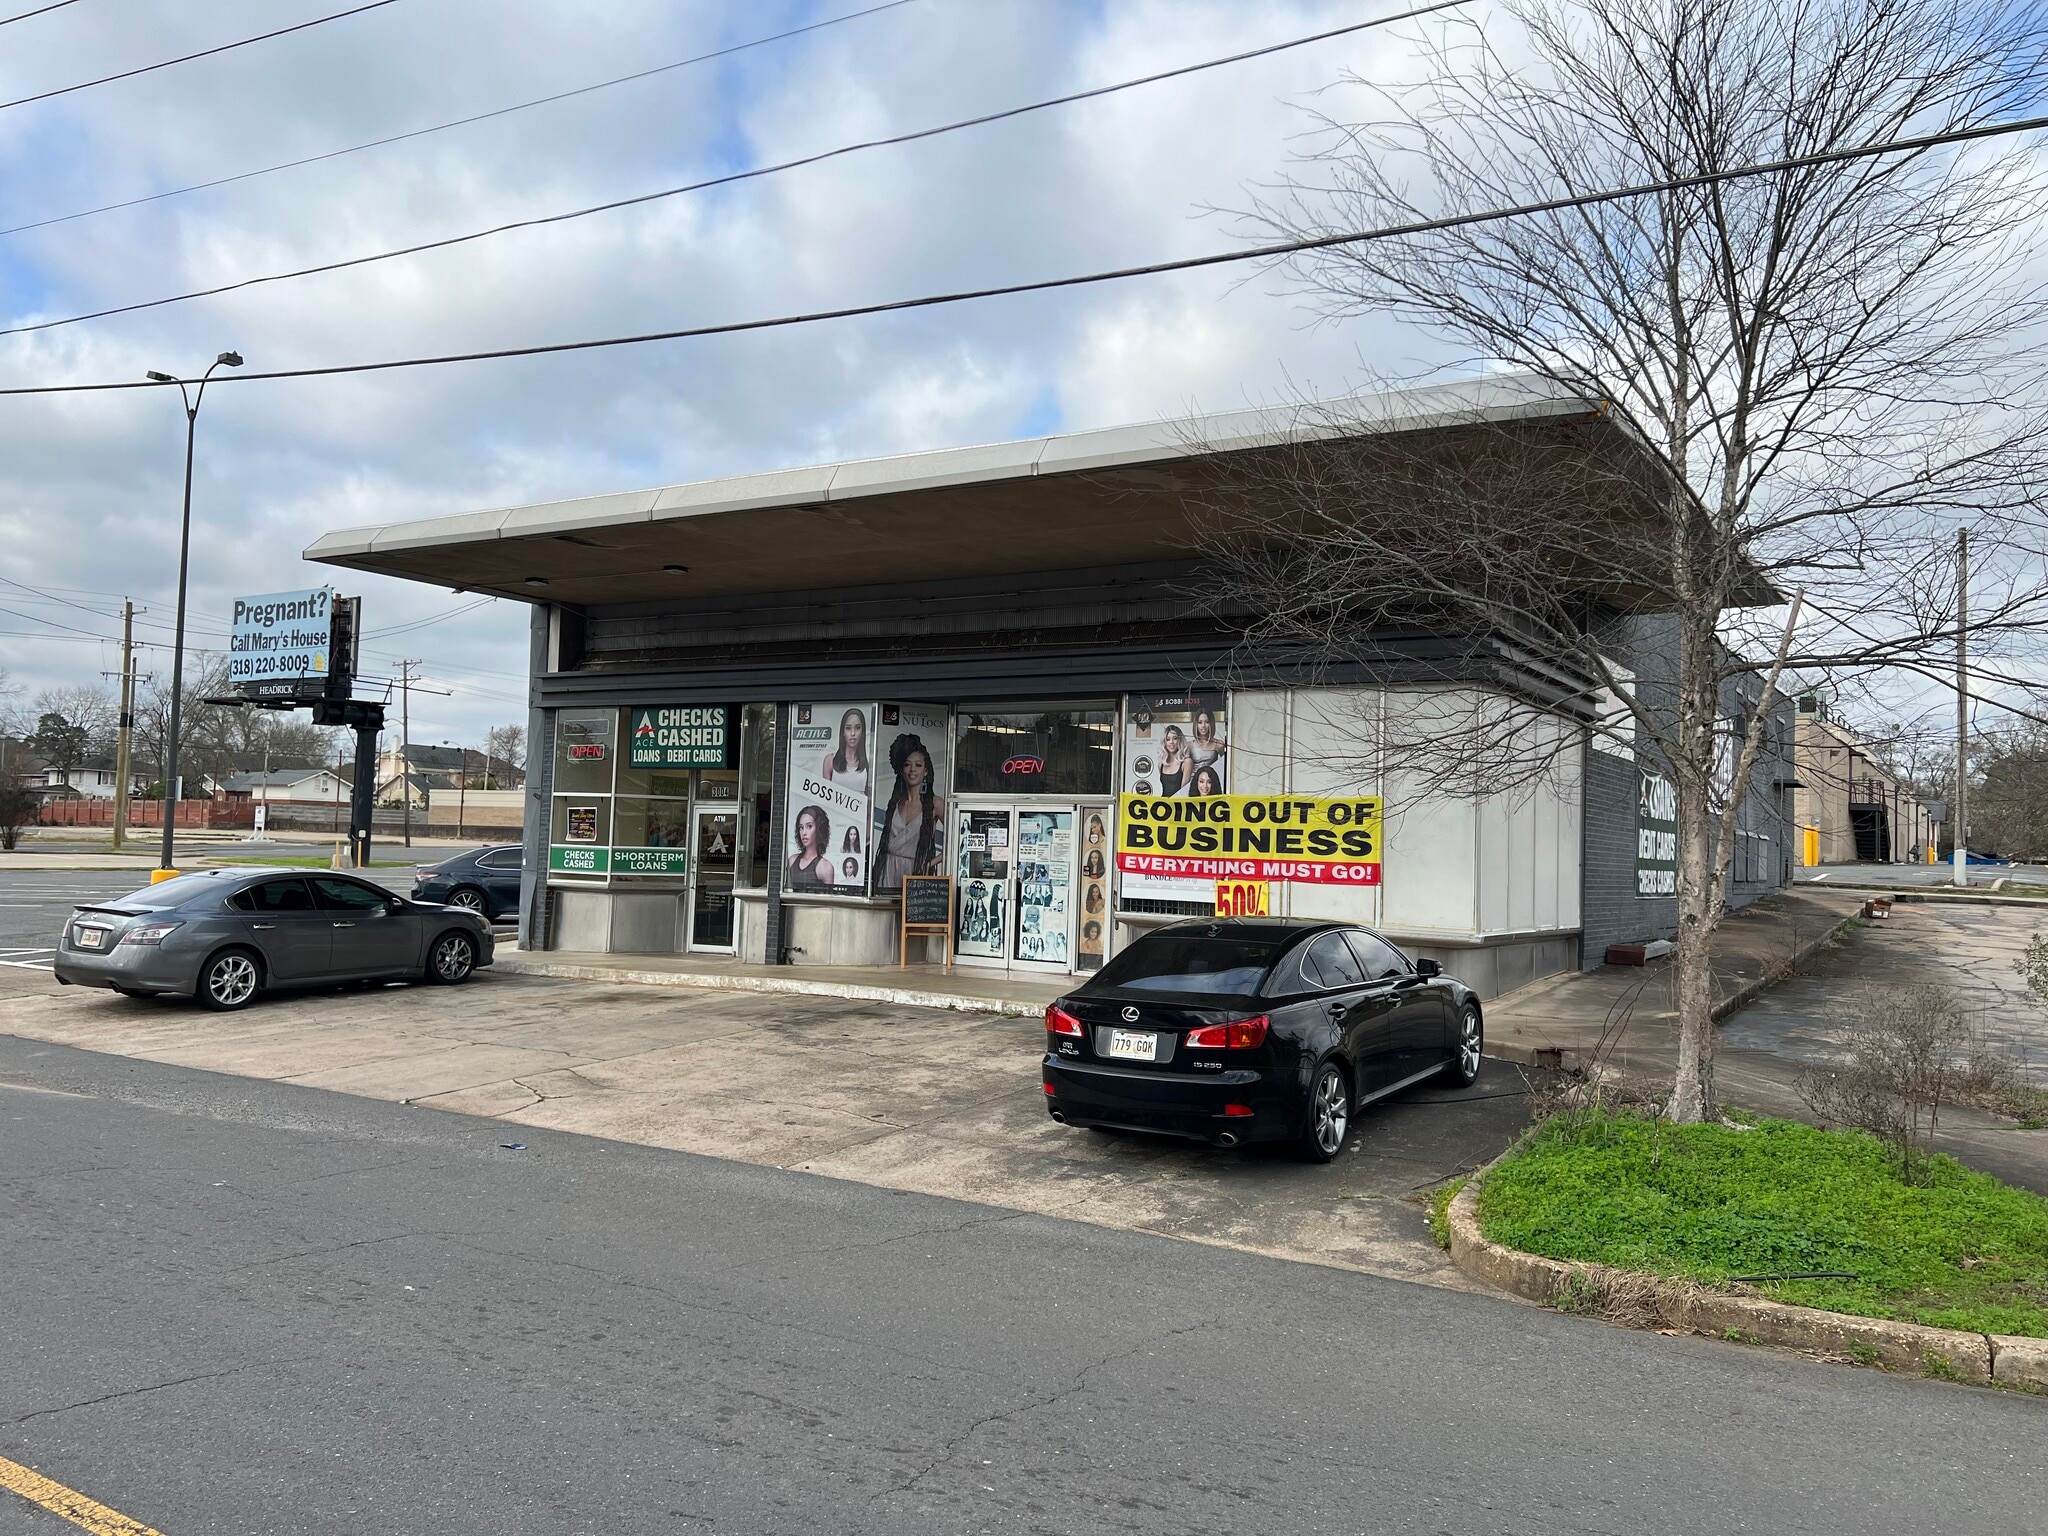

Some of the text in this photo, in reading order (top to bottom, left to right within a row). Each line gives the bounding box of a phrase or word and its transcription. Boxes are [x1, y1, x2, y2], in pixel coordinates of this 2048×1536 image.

[234, 592, 327, 628] Pregnant?
[230, 629, 327, 652] Call Mary's House
[230, 654, 309, 678] (318) 220-8009
[260, 685, 294, 694] HEADRICK
[658, 708, 724, 726] CHECKS
[902, 716, 918, 726] NU
[658, 728, 724, 746] CASHED
[796, 729, 828, 738] ACTIVE
[636, 739, 654, 747] ACE
[572, 746, 602, 758] OPEN
[633, 750, 722, 763] LOANS DEBIT CARDS
[1002, 760, 1044, 774] OPEN
[712, 788, 728, 797] 3004
[802, 778, 860, 812] BOSS WIG
[1128, 800, 1375, 826] GOING OUT OF
[968, 839, 976, 847] 20%
[1126, 824, 1373, 857] BUSINESS
[564, 851, 594, 860] CHECKS
[614, 852, 684, 862] SHORT-TERM
[564, 859, 594, 868] CASHED
[630, 861, 668, 870] LOANS
[1125, 856, 1372, 880] EVERYTHING MUST GO!
[1217, 884, 1266, 916] 50%
[1115, 1038, 1154, 1054] 779 GQK
